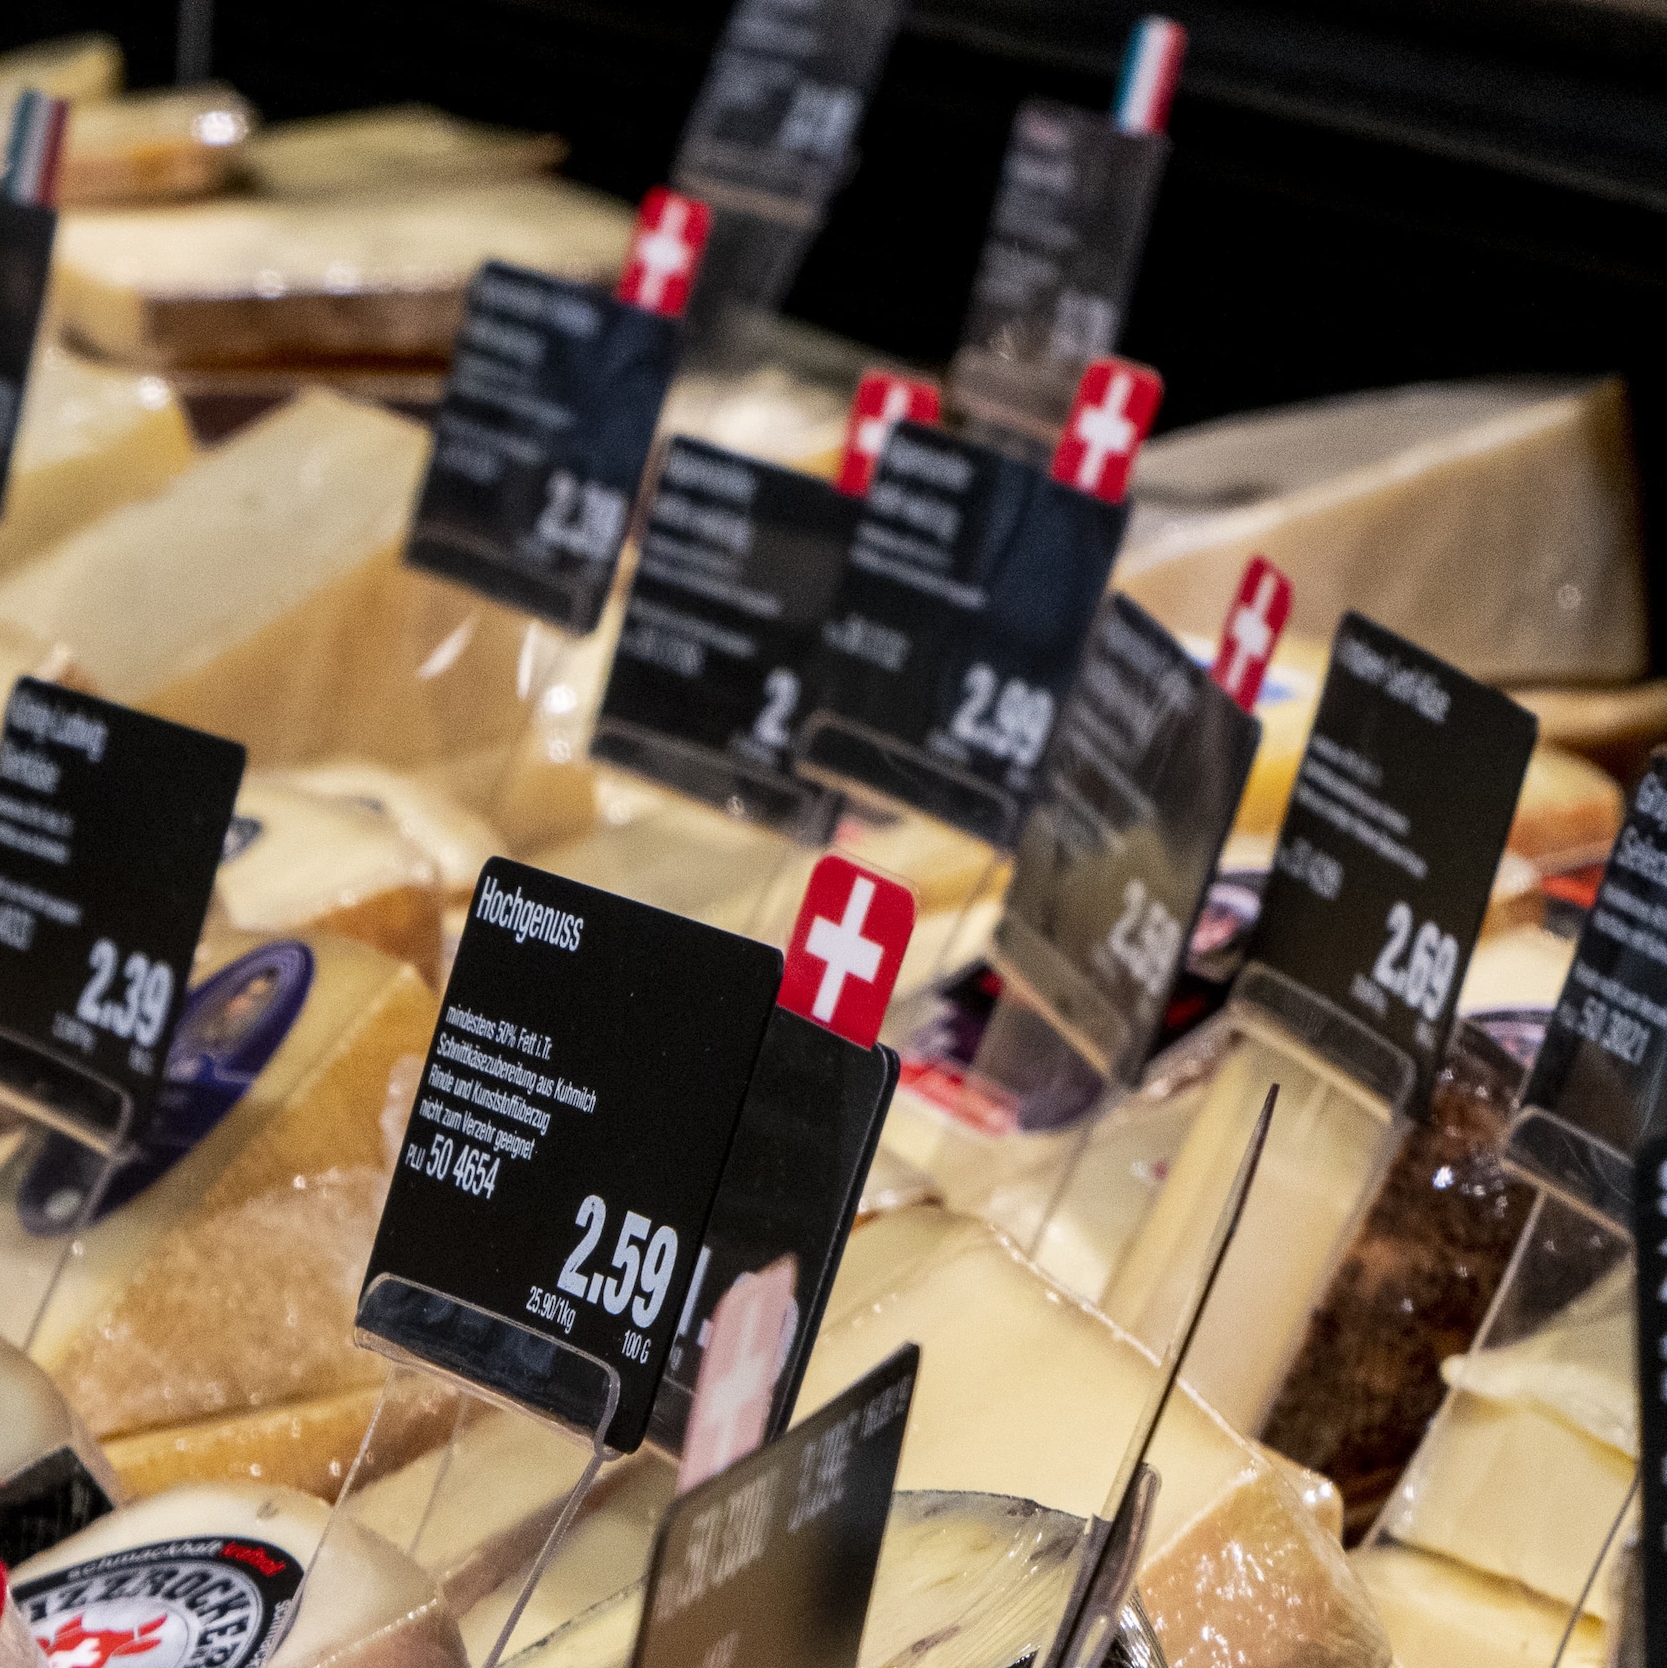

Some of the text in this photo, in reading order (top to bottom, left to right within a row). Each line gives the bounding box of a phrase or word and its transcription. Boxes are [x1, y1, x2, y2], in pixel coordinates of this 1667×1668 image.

[949, 662, 1057, 766] 2.99
[476, 876, 584, 951] Hochgenuss
[77, 940, 172, 1046] 2.39
[1374, 904, 1457, 1020] 2.69
[446, 1006, 552, 1059] mindestens 50% Fett i.Tr.
[429, 1064, 551, 1136] Rinde und Kunststoffüberzug
[437, 1032, 596, 1112] Schnittkäsezubereitung aus Kuhmilch
[406, 1134, 500, 1198] PLU 50 4654
[420, 1099, 535, 1159] nicht zum Verzehr geeignet
[557, 1195, 678, 1328] 2.59
[526, 1286, 651, 1364] 25.90/1kg 100 G
